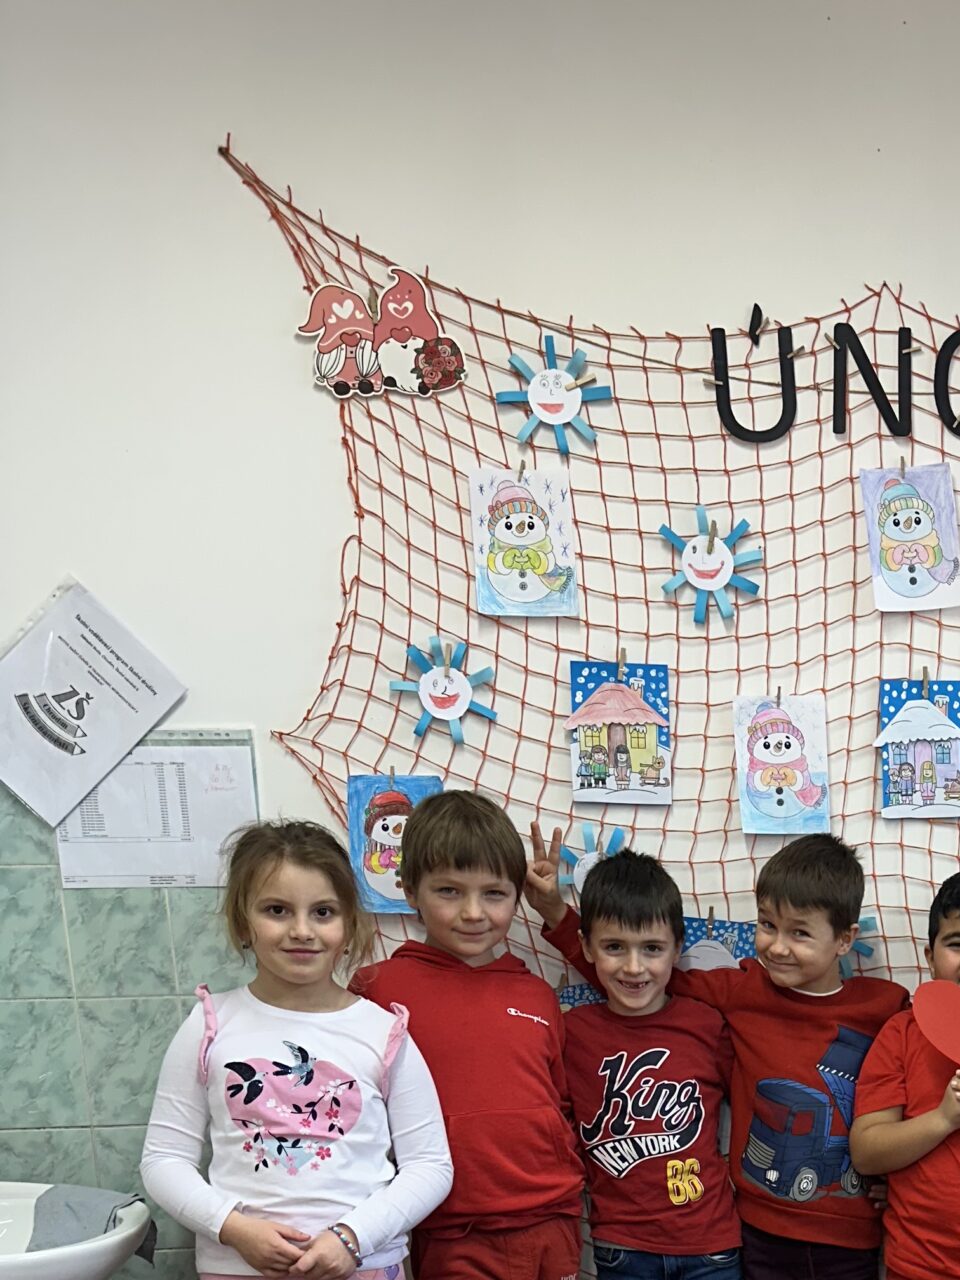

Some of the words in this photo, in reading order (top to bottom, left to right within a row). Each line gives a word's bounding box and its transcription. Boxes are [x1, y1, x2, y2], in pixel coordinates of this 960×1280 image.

[51, 684, 94, 721] ZŠ
[580, 1047, 705, 1143] King
[593, 1138, 640, 1176] NEW
[633, 1134, 681, 1160] YORK
[666, 1157, 705, 1206] 86
